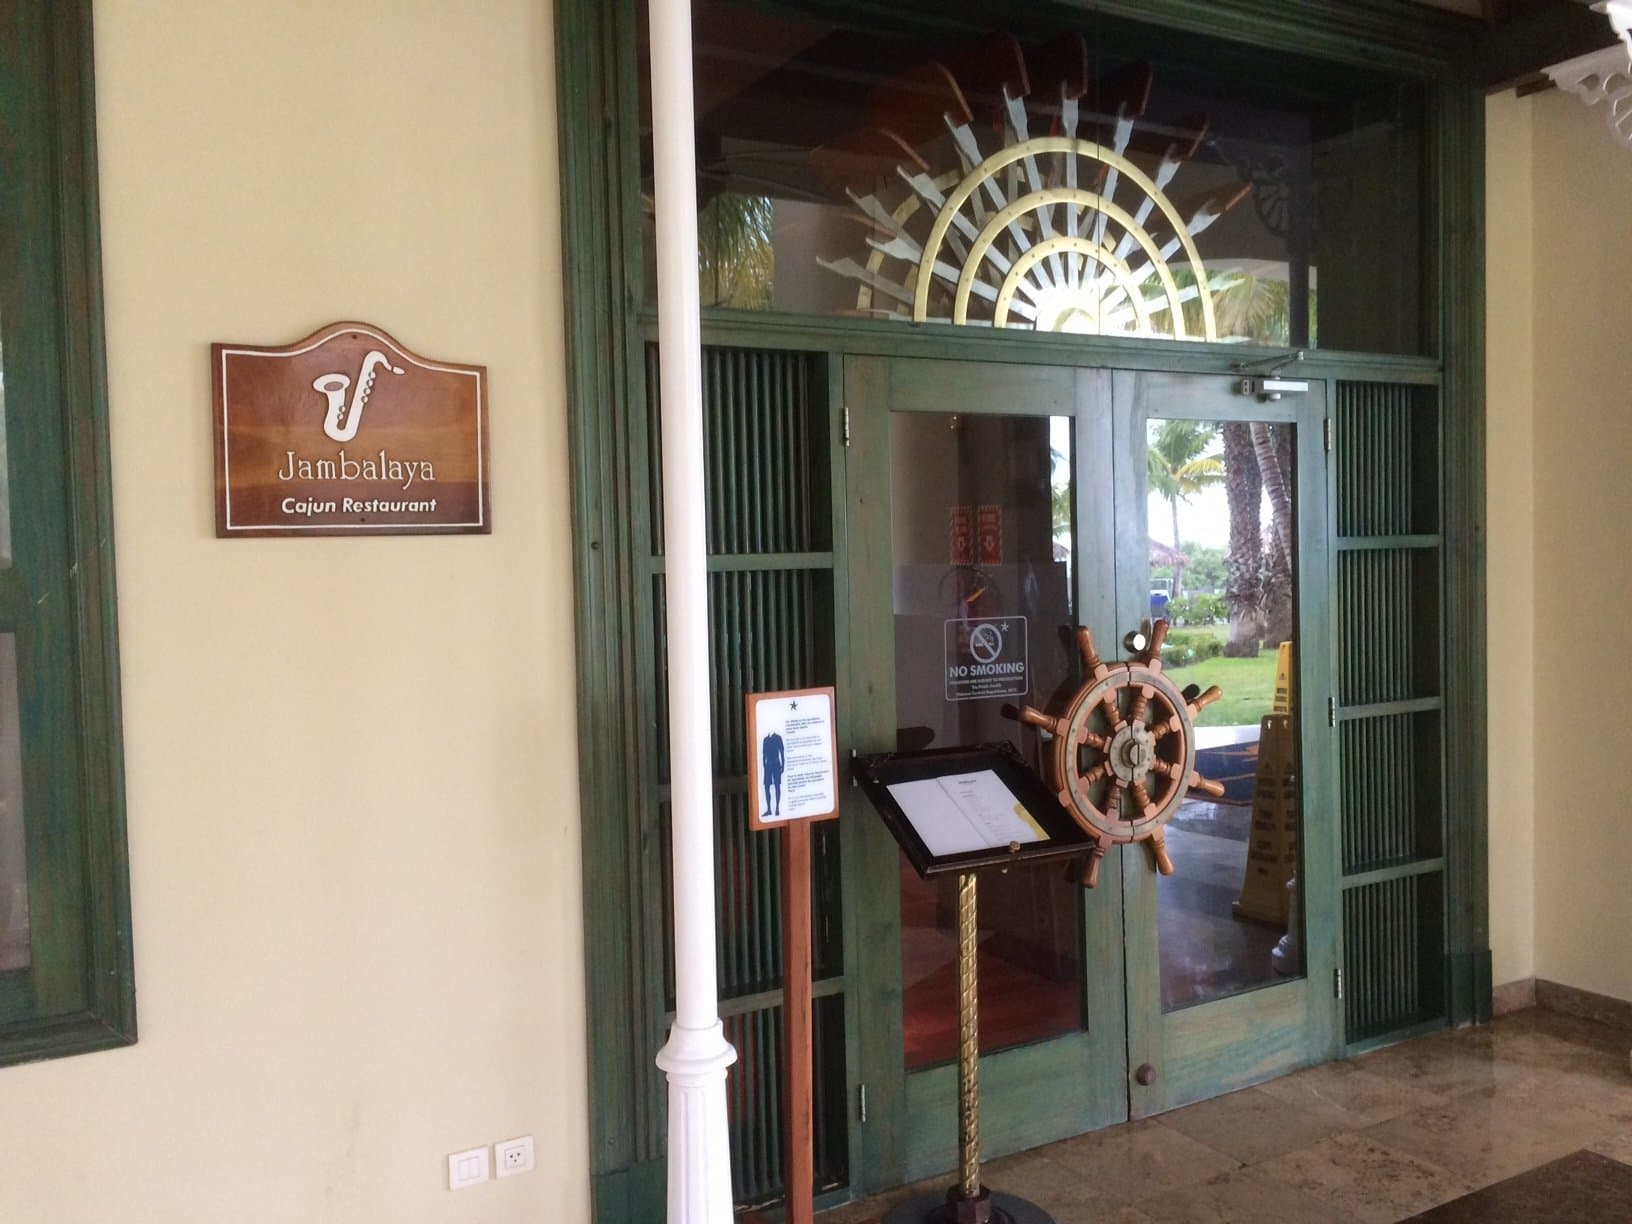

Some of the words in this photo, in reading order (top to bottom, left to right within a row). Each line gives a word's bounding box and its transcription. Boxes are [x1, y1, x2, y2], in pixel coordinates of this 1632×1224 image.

[278, 450, 436, 490] Jambalaya
[281, 497, 337, 516] Cajun
[342, 498, 437, 513] Restaurant
[949, 665, 968, 677] NO
[970, 662, 1025, 676] SMOKING
